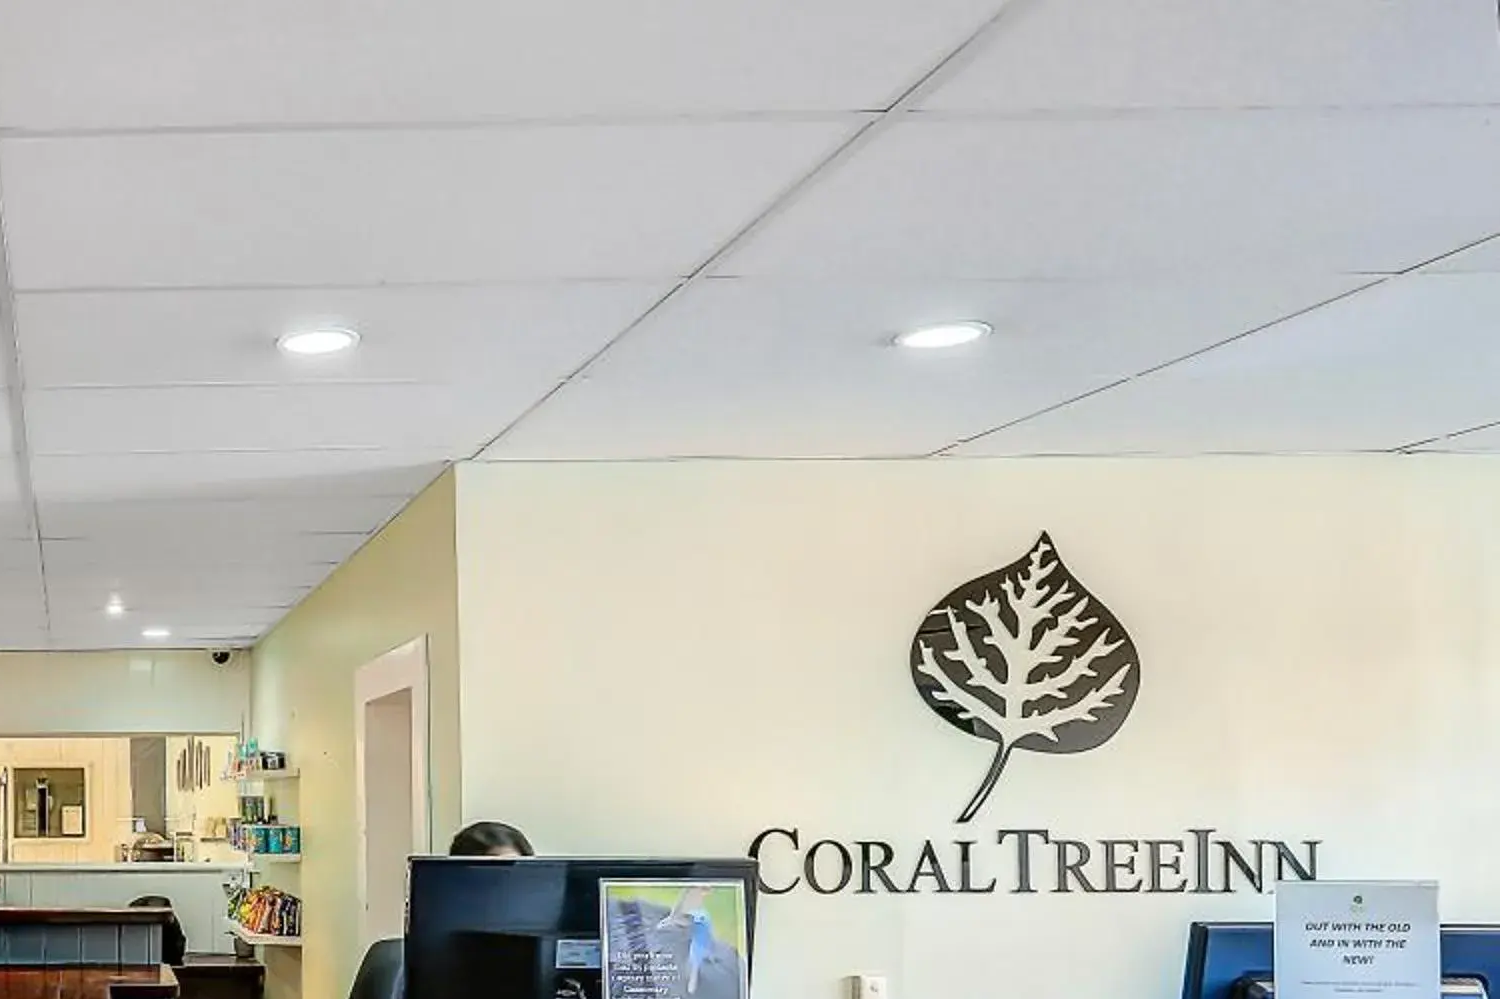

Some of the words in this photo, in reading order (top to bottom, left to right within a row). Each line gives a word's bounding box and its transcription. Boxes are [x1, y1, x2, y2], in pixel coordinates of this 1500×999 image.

[748, 827, 997, 894] CORAL
[1305, 923, 1329, 932] OUT
[1331, 923, 1361, 932] WITH
[1365, 923, 1386, 932] THE
[1387, 923, 1411, 932] OLD
[1309, 939, 1335, 948] AND
[1337, 939, 1350, 948] IN
[1352, 939, 1383, 948] WITH
[1385, 939, 1407, 949] THE
